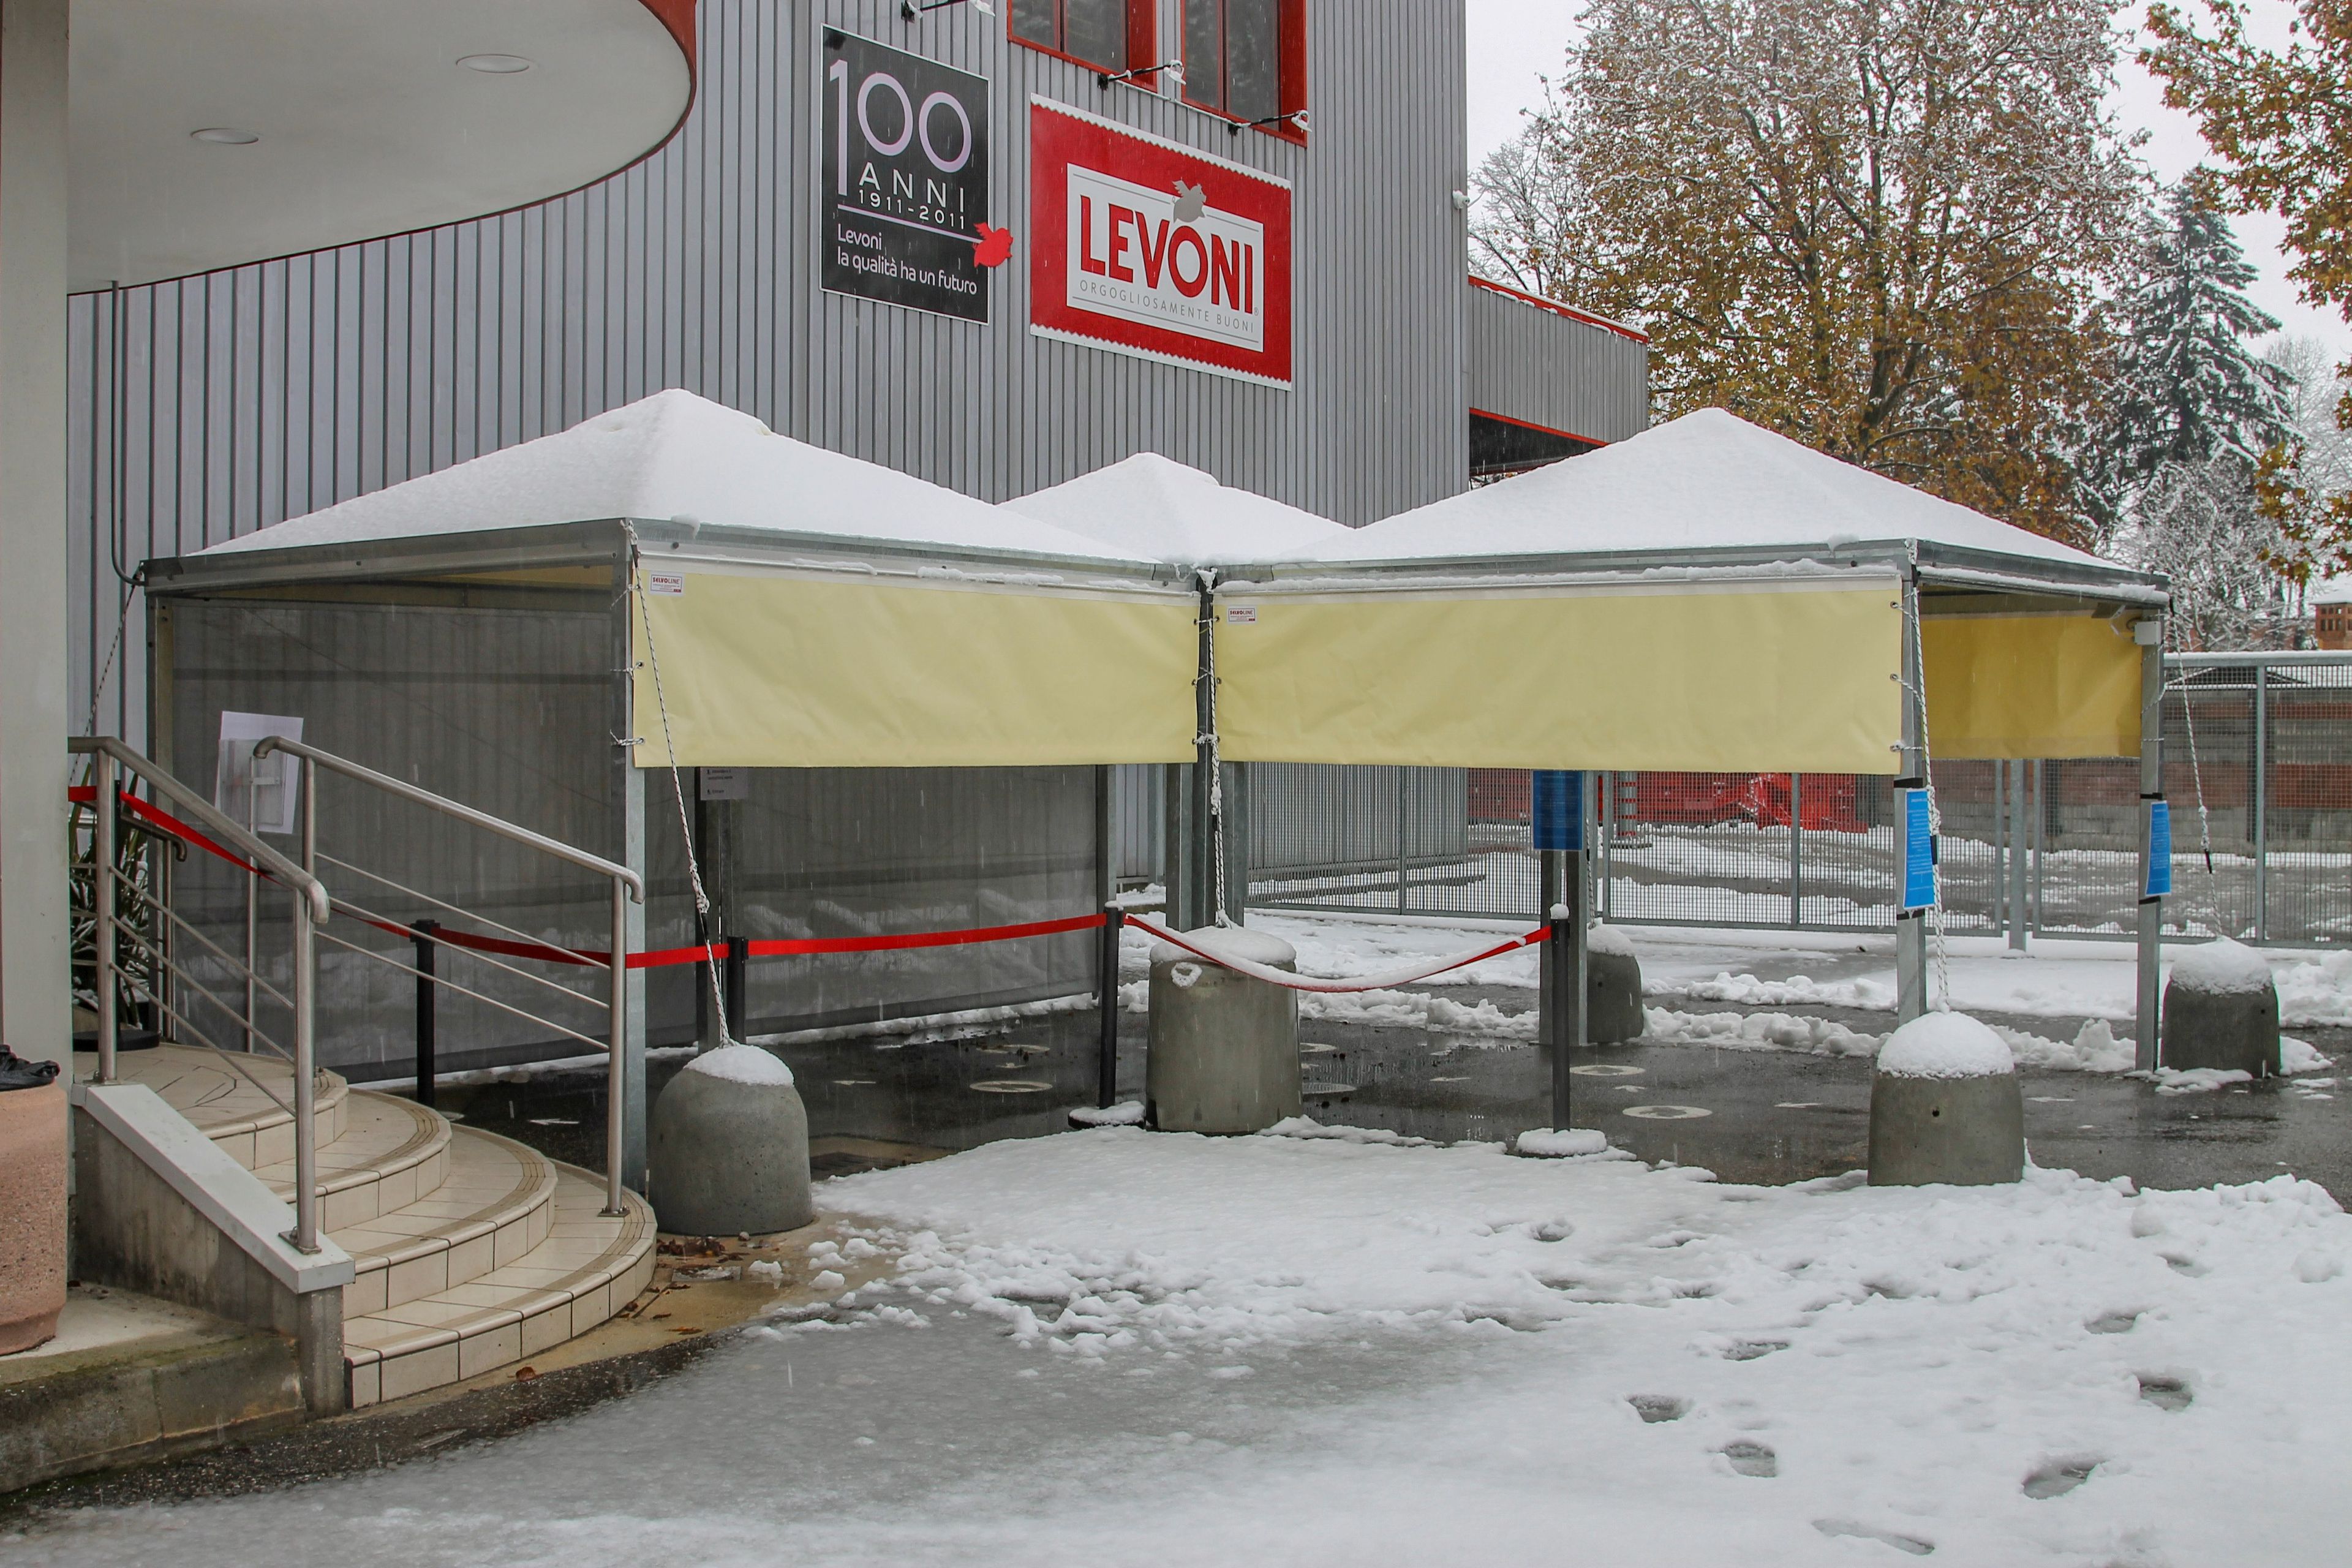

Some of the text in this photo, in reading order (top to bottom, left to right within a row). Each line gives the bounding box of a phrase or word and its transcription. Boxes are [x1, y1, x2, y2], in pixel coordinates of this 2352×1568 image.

[829, 59, 972, 196] 100
[859, 162, 964, 213] ANNI
[859, 189, 965, 230] 1911-2011
[838, 223, 882, 251] Levoni
[1080, 194, 1253, 314] LEVONI
[837, 246, 978, 295] la qualità ha un futuro
[1079, 279, 1254, 333] ORGOGLIOSAMENTE BUONI
